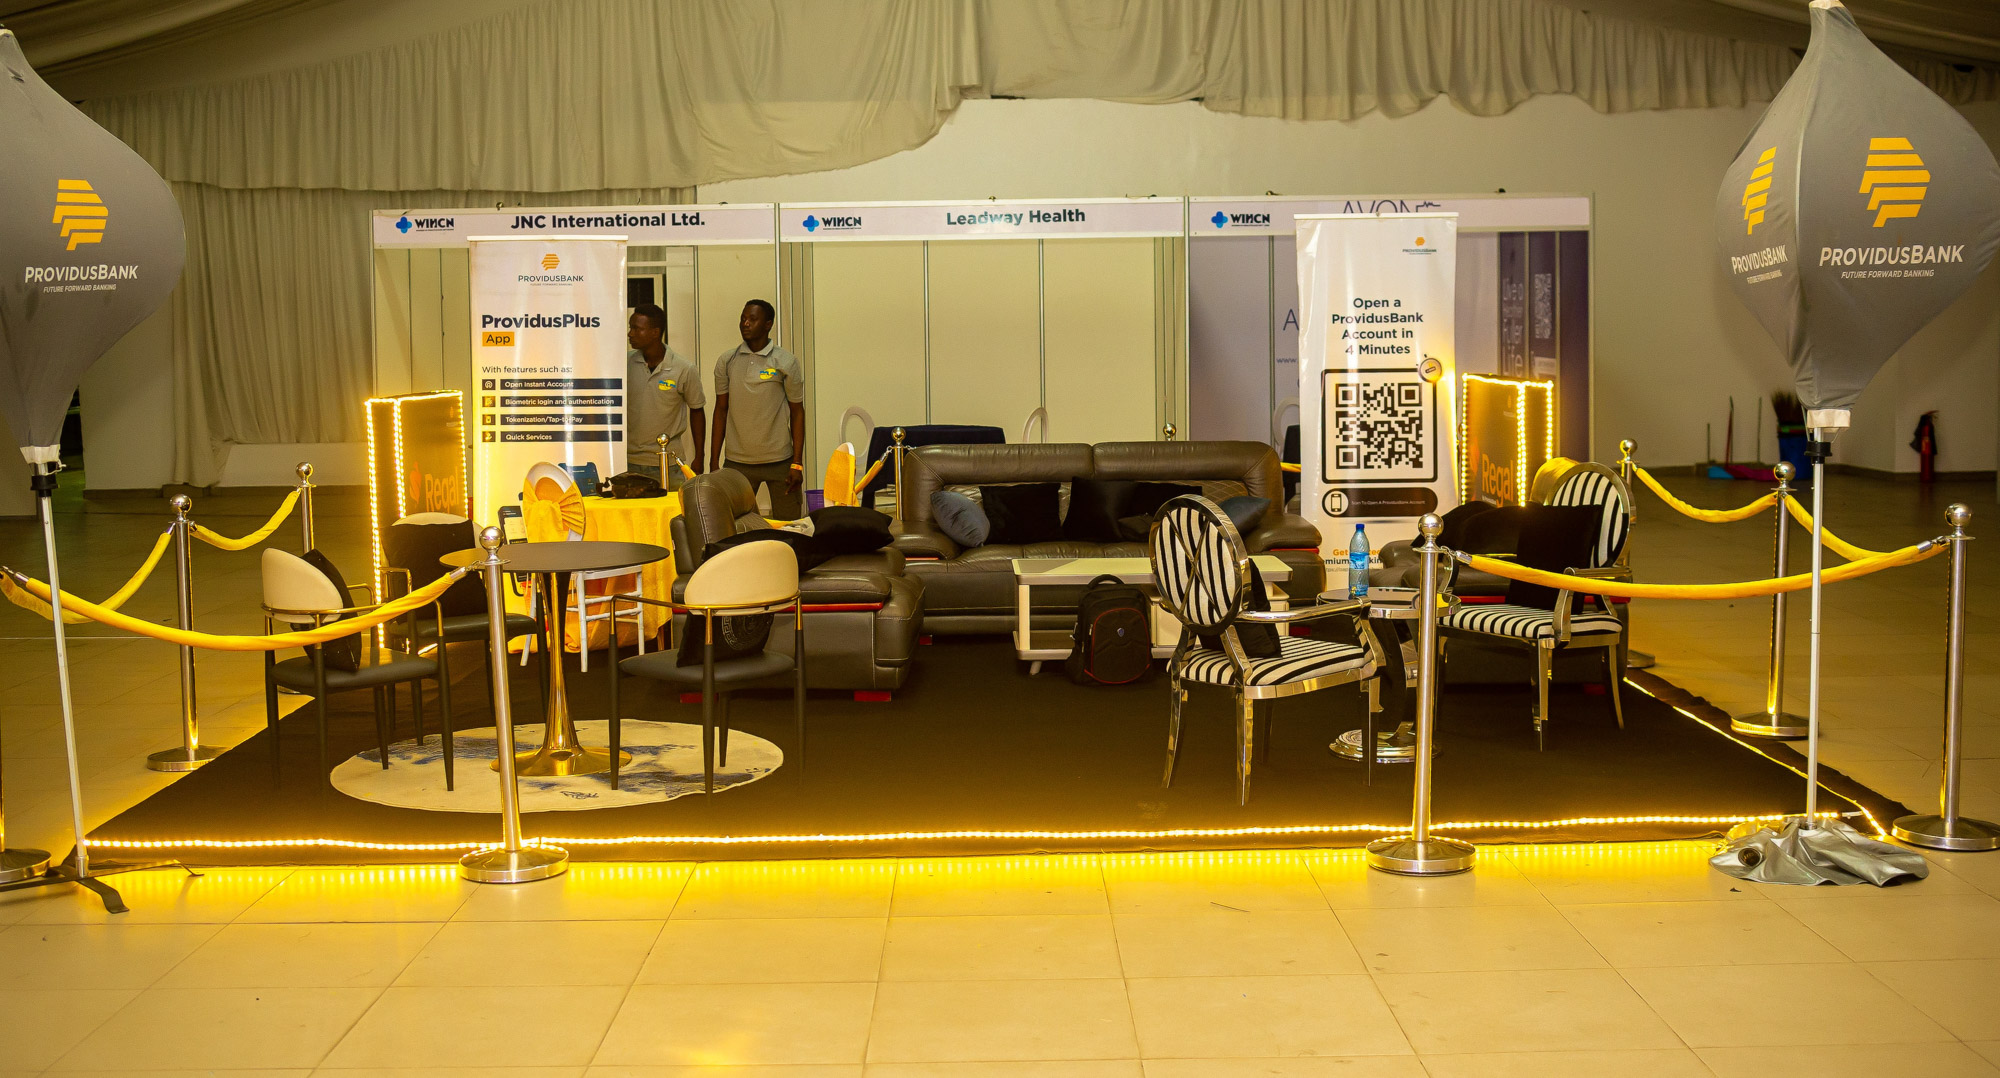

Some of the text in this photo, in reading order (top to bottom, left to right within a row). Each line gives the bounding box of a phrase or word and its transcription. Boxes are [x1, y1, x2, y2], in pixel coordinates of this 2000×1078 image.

[510, 212, 705, 229] JNC International Ltd.
[946, 209, 1086, 226] Leadway Health
[1841, 269, 1935, 279] FUTURE FORWARD BANKING
[43, 286, 64, 294] FUTURE
[92, 283, 117, 291] BANKING
[1353, 297, 1401, 310] Open a
[481, 313, 600, 328] ProvidusPlus
[1331, 312, 1424, 325] ProvidusBank
[486, 334, 511, 345] App
[1341, 328, 1414, 340] Account in
[1345, 344, 1411, 355] 4 Minutes
[504, 381, 523, 389] Open
[1482, 453, 1514, 508] Regal
[1332, 548, 1349, 556] Get
